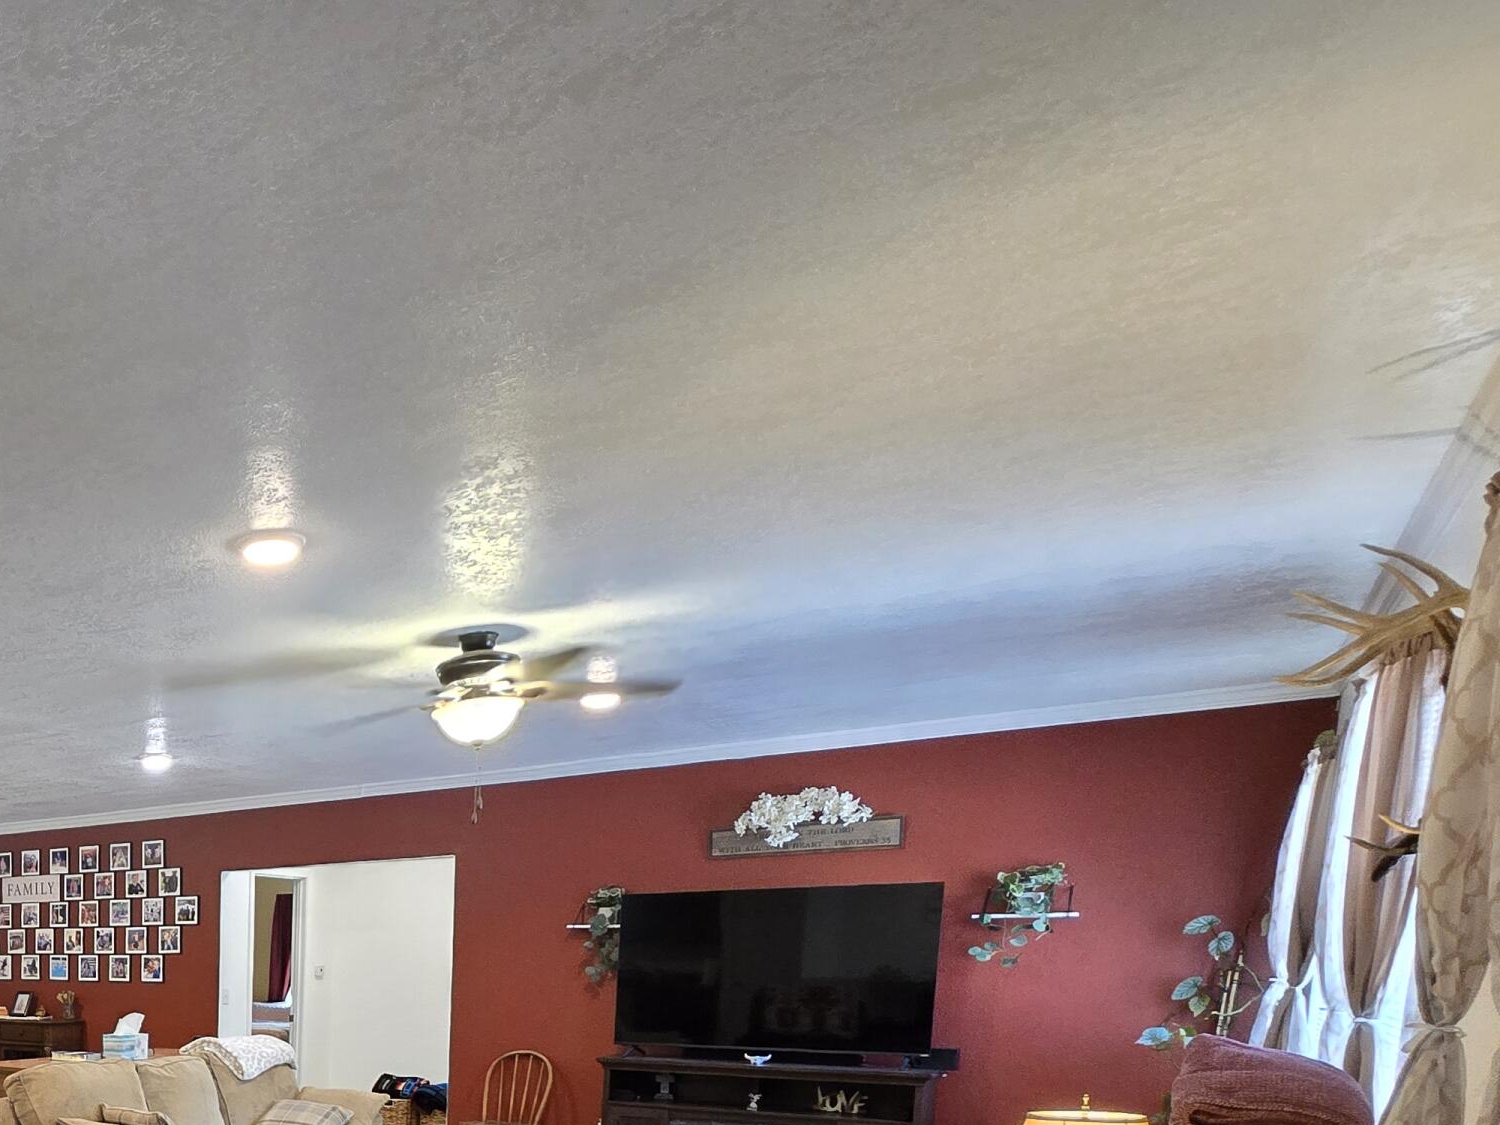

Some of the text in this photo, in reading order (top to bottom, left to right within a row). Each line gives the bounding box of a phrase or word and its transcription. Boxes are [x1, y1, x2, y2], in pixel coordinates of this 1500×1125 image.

[830, 826, 854, 834] LORD
[792, 841, 823, 850] HEART
[835, 837, 878, 846] PROVERBS
[7, 881, 54, 896] FAMILY
